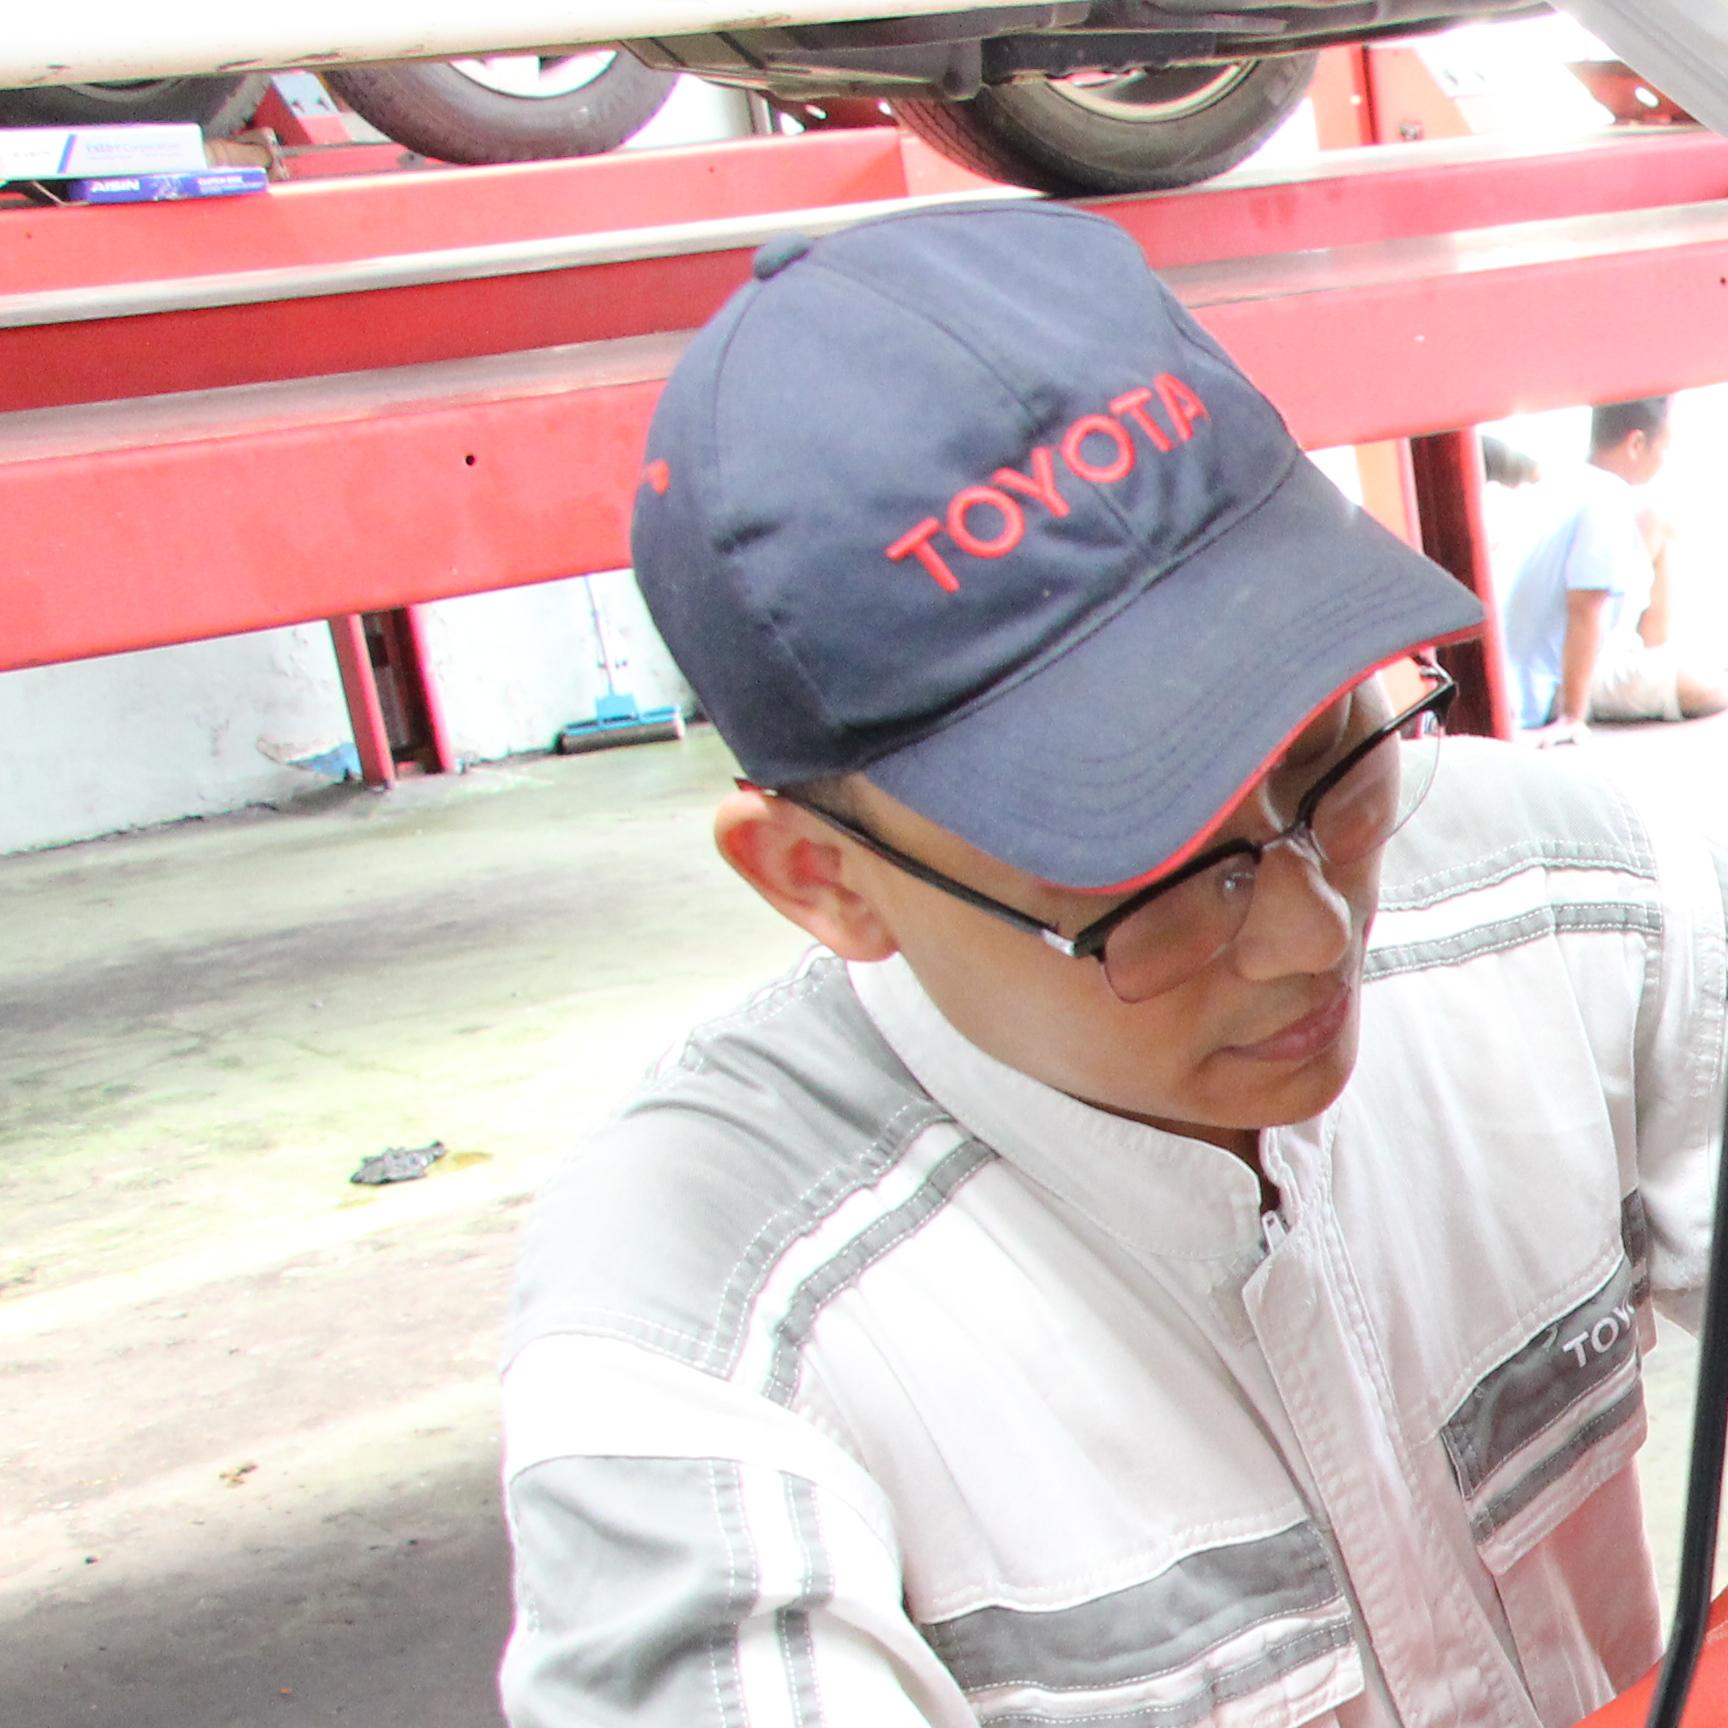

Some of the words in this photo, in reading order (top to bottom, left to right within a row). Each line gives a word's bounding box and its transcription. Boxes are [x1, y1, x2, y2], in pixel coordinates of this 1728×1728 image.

[91, 179, 140, 193] AISIN
[886, 372, 1208, 594] TOYOTA
[1562, 1299, 1637, 1369] TOY
